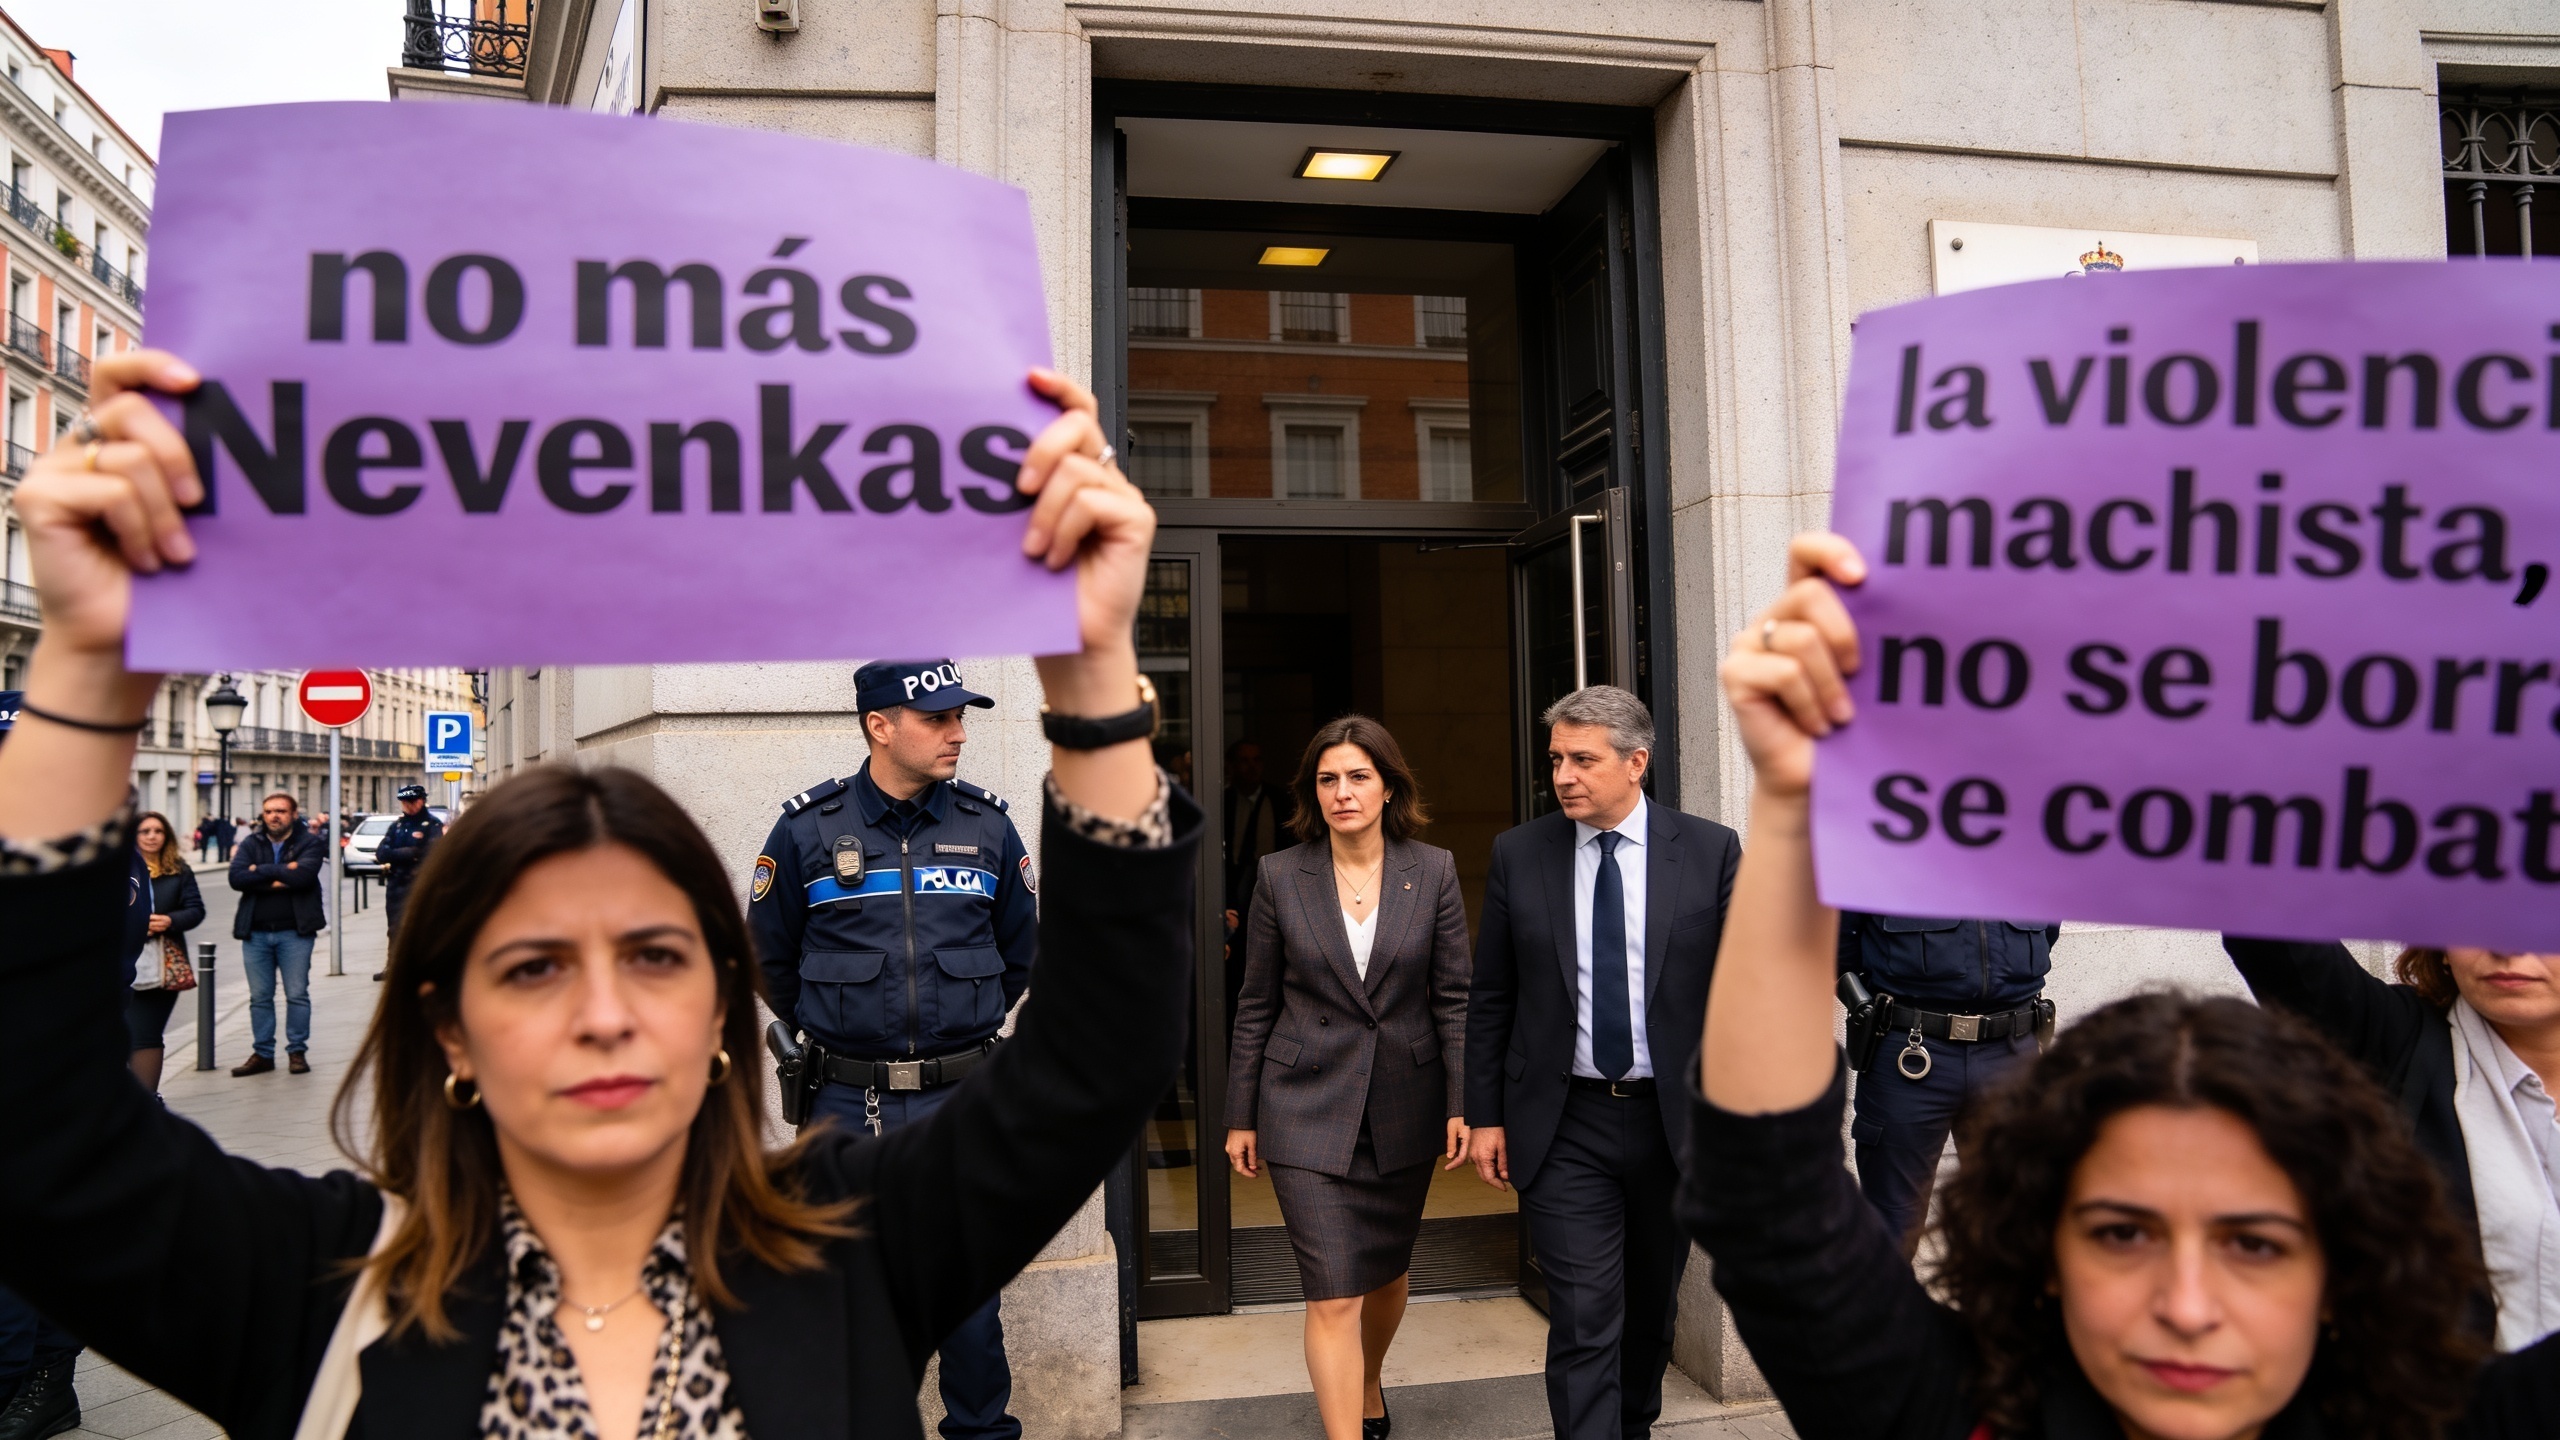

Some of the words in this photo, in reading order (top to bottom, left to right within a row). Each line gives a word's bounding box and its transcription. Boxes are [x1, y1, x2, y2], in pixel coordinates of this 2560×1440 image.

[308, 251, 525, 346] no
[576, 237, 916, 354] más
[184, 380, 1040, 516] Nevenkas
[1893, 343, 1992, 433] la
[1885, 467, 2552, 608] machista,
[437, 718, 461, 749] P
[1876, 632, 2032, 713] no
[2062, 640, 2214, 723] se
[2248, 615, 2560, 740] borr
[1872, 772, 2010, 849] se
[2039, 764, 2560, 886] combat
